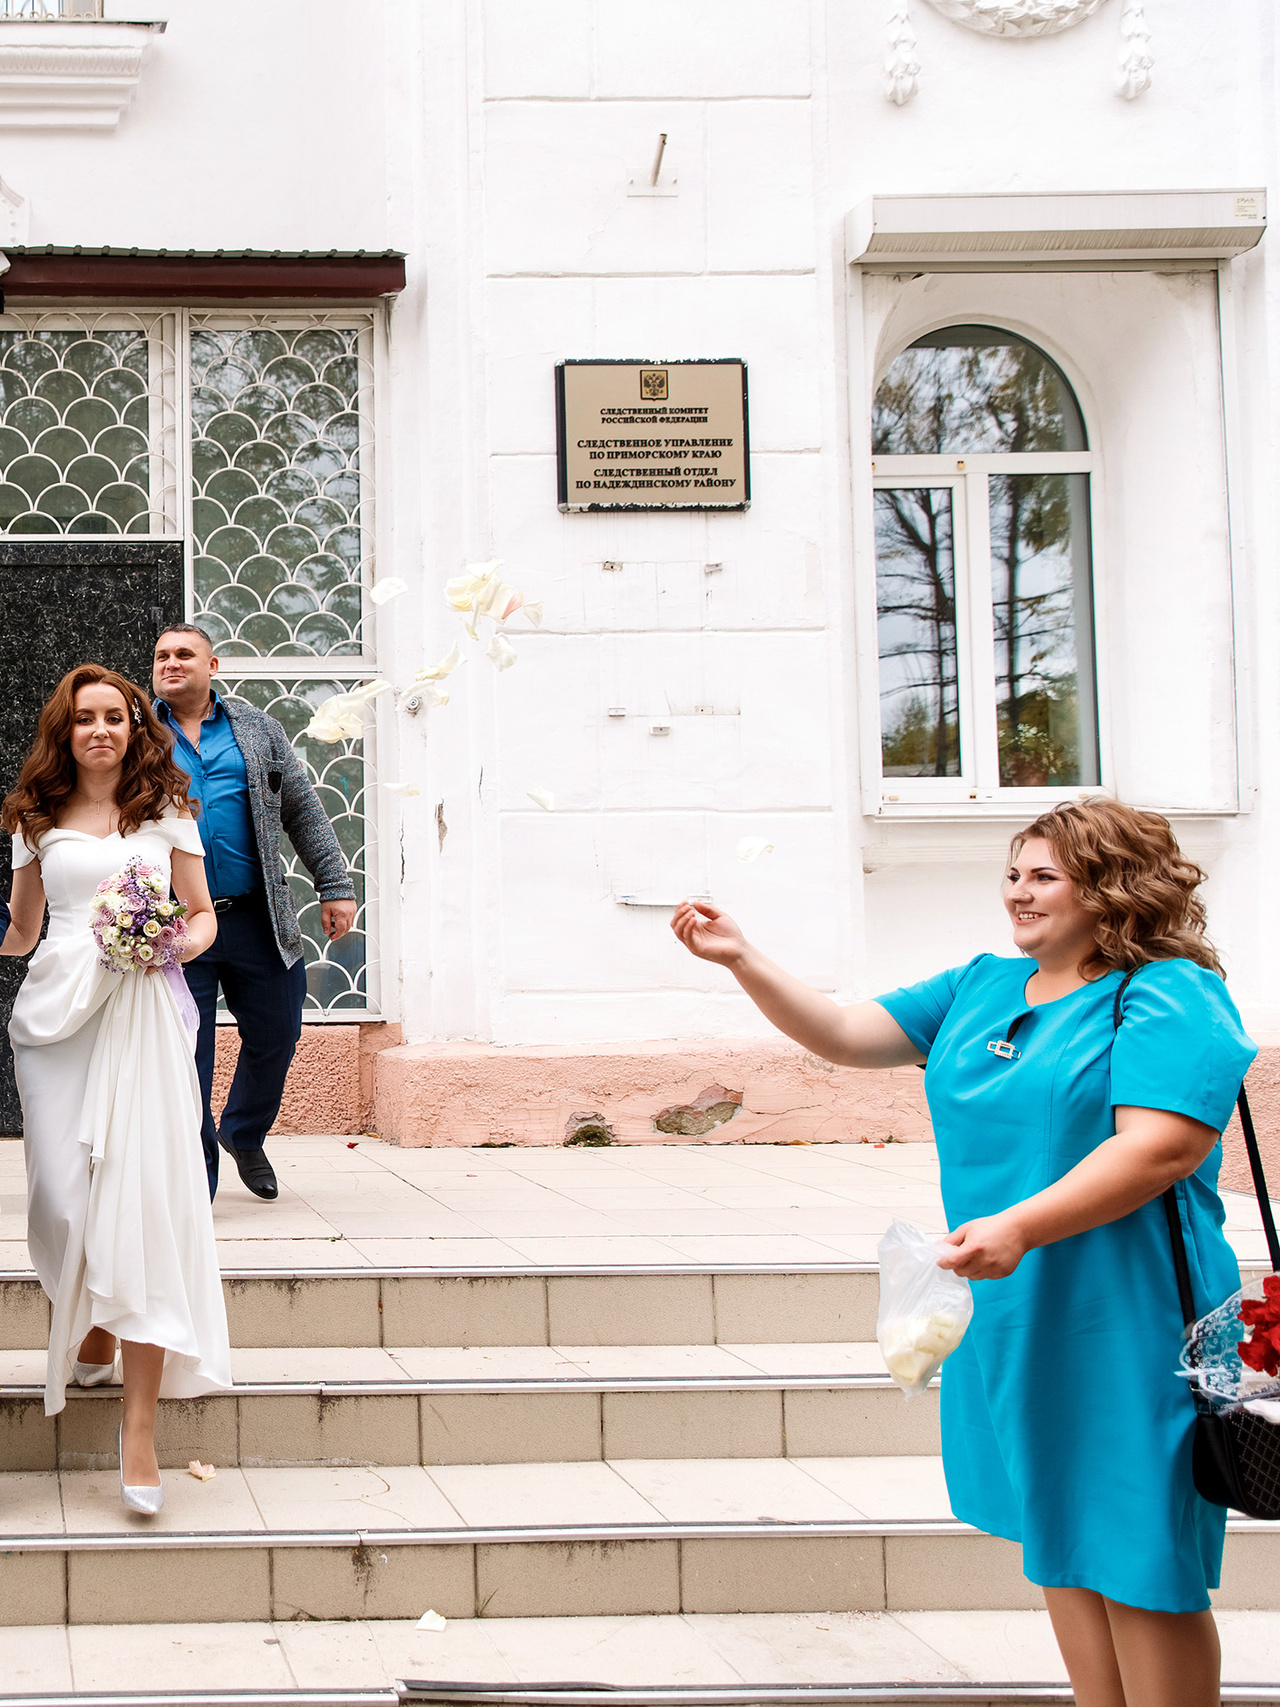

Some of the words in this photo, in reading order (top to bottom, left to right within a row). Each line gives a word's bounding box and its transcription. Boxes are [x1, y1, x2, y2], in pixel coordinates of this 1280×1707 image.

[600, 407, 667, 415] СЛЕДСТВЕННЫЙ
[577, 440, 662, 448] СЛЕДСТВЕННОЕ
[664, 439, 733, 447] УПРАВЛЕНИЕ
[589, 451, 604, 459] ПО
[607, 451, 689, 459] ПРИМОРСКОМУ
[692, 450, 722, 458] КРАЮ
[594, 467, 681, 477] СЛЕДСТВЕННЫЙ
[684, 468, 718, 476] ОТДЕЛ
[576, 481, 591, 489] ПО
[593, 480, 692, 489] НАДЕЖДИНСКОМУ
[694, 478, 736, 487] РАЙОНУ
